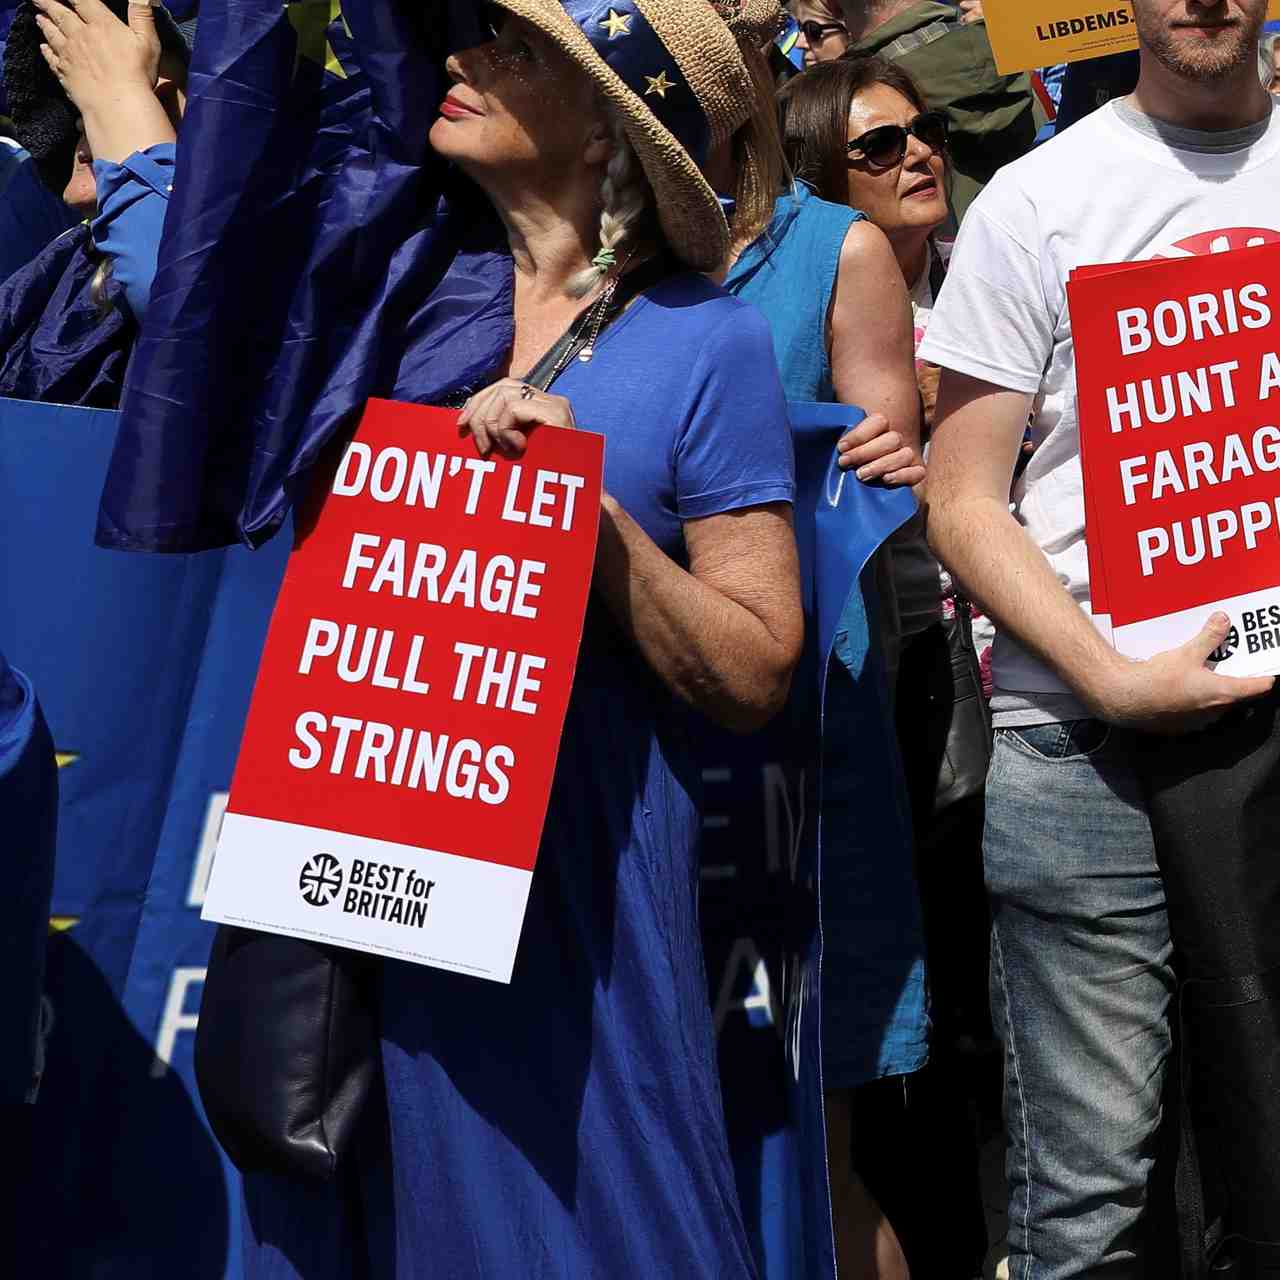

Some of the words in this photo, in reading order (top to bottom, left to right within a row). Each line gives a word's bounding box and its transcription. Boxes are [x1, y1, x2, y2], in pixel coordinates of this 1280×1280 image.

[1116, 282, 1273, 357] BORIS
[1105, 359, 1240, 434] HUNT
[331, 440, 497, 516] DON'T
[501, 463, 585, 532] LET
[340, 531, 547, 621] FARAGE
[297, 617, 431, 696] PULL
[452, 641, 547, 716] THE
[287, 710, 516, 807] STRINGS
[343, 887, 429, 929] BRITAIN
[348, 858, 402, 895] BEST
[404, 868, 436, 901] for
